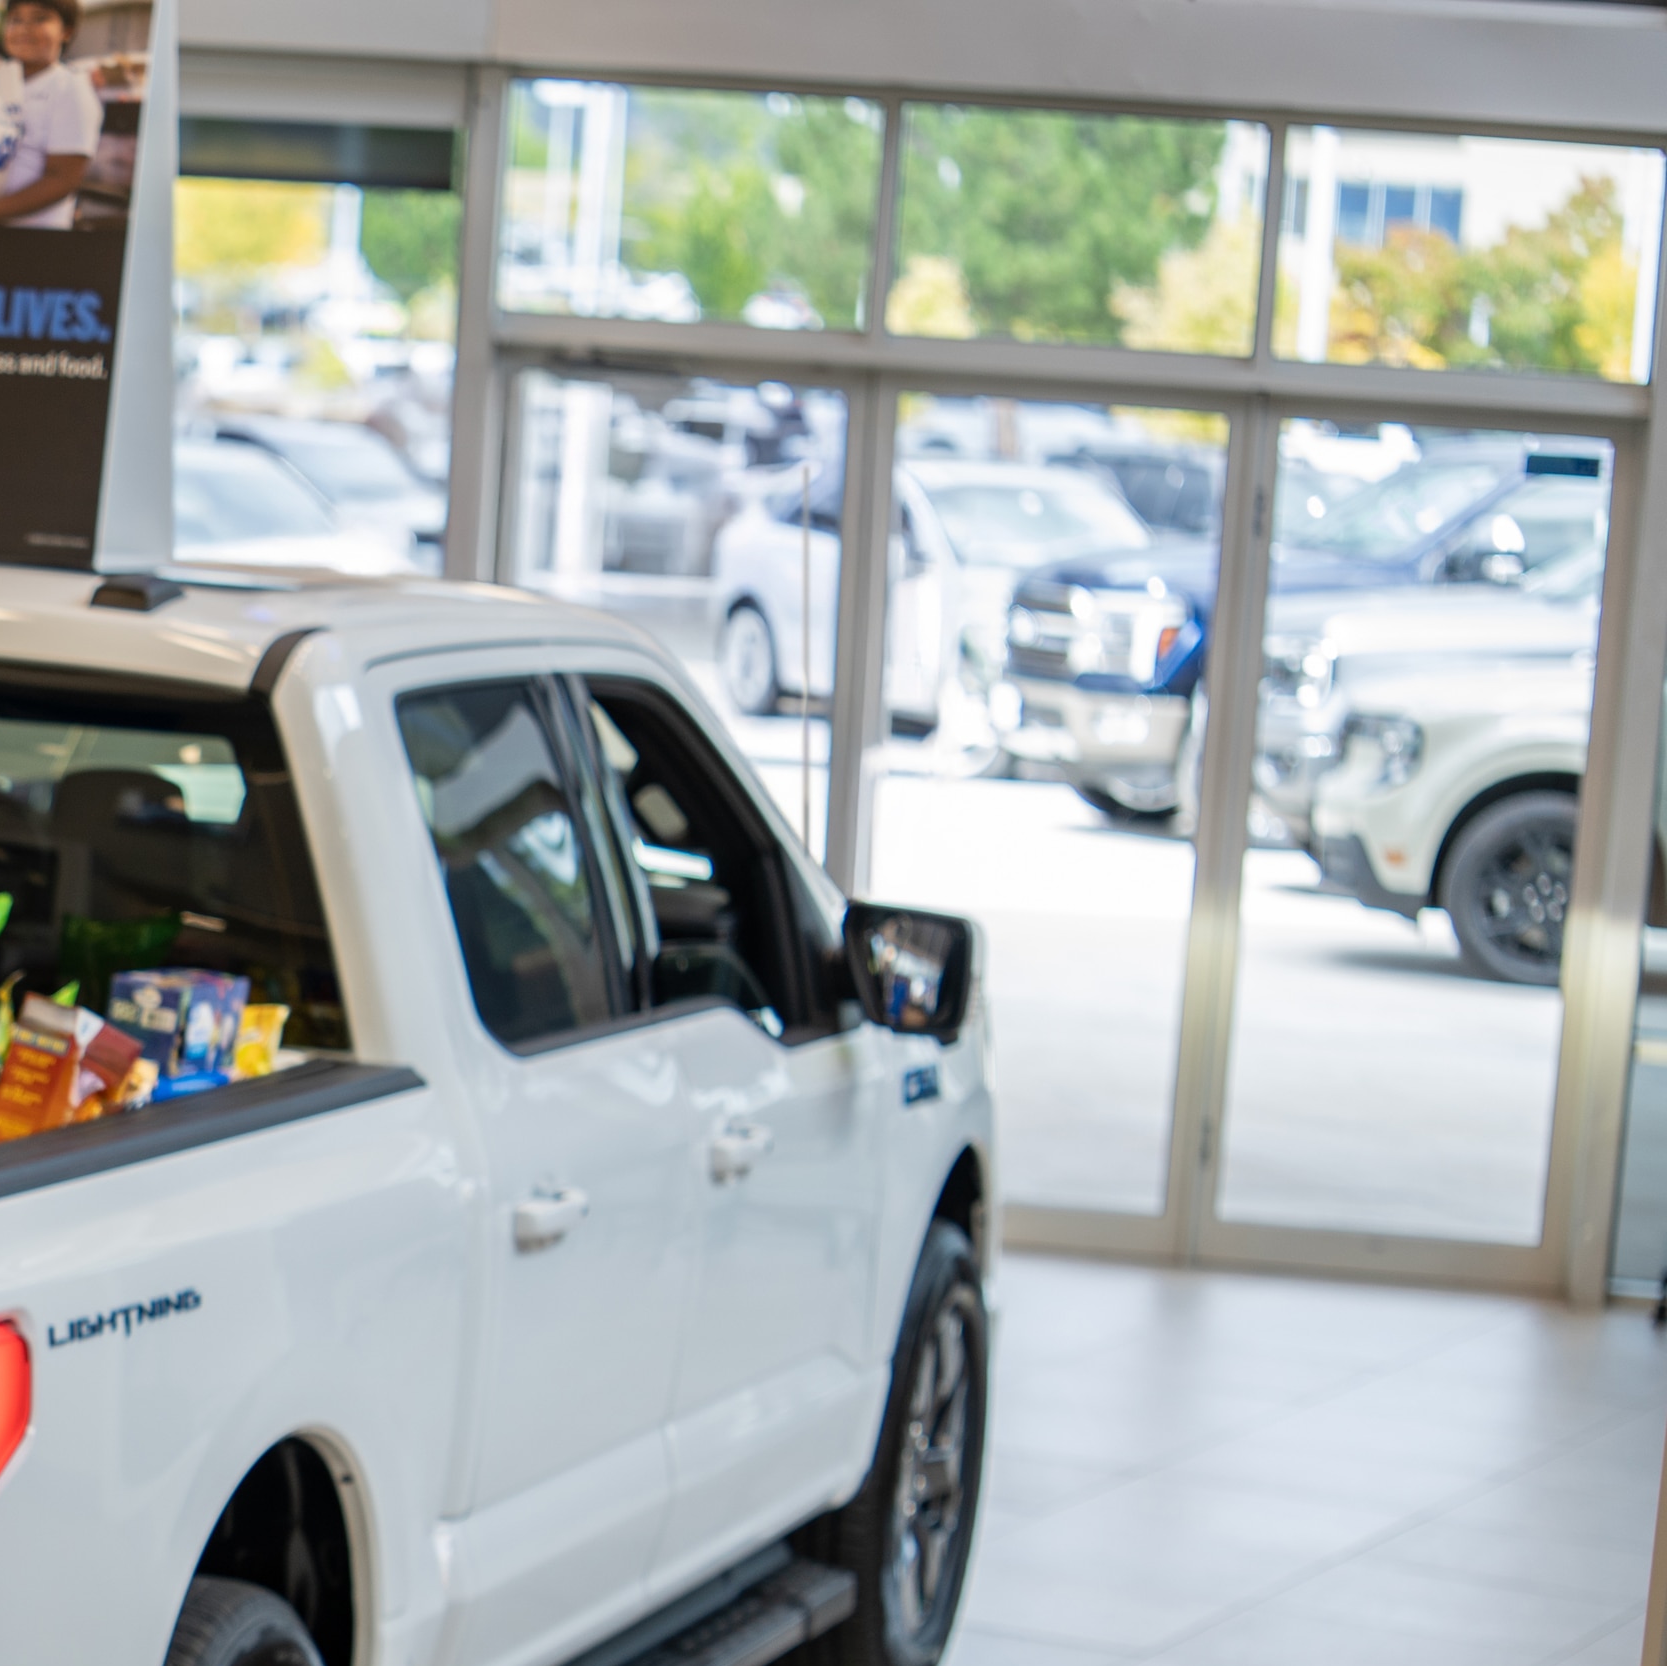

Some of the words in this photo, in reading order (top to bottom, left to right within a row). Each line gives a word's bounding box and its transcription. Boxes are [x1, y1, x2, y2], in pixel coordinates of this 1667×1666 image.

[18, 349, 57, 376] and
[58, 351, 109, 380] food.
[47, 1287, 203, 1349] LIGHTNING
